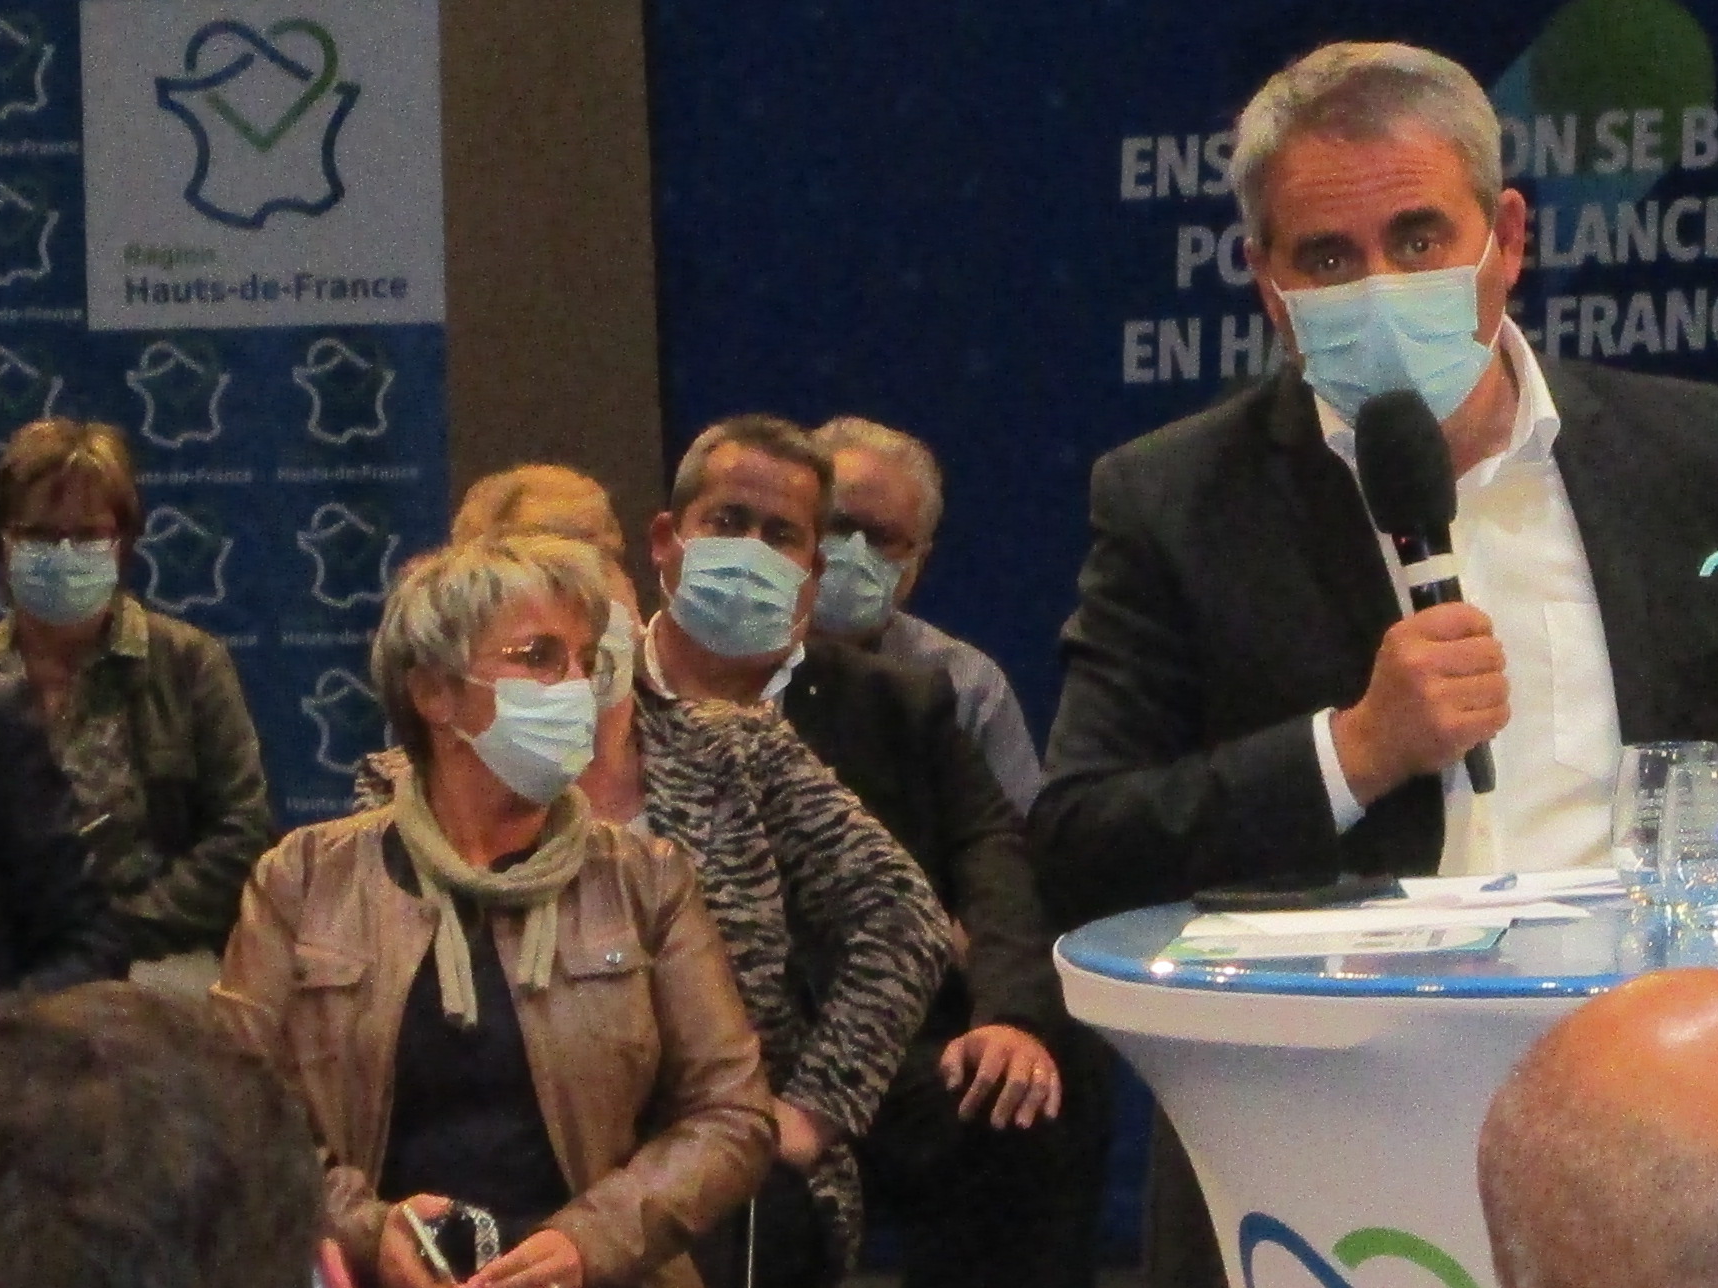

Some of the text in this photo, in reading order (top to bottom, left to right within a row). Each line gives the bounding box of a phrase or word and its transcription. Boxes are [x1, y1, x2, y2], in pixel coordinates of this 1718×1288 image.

[1592, 107, 1665, 174] SE
[124, 270, 409, 305] Hauts-de-France
[1176, 221, 1257, 290] PO
[1123, 316, 1201, 385] EN
